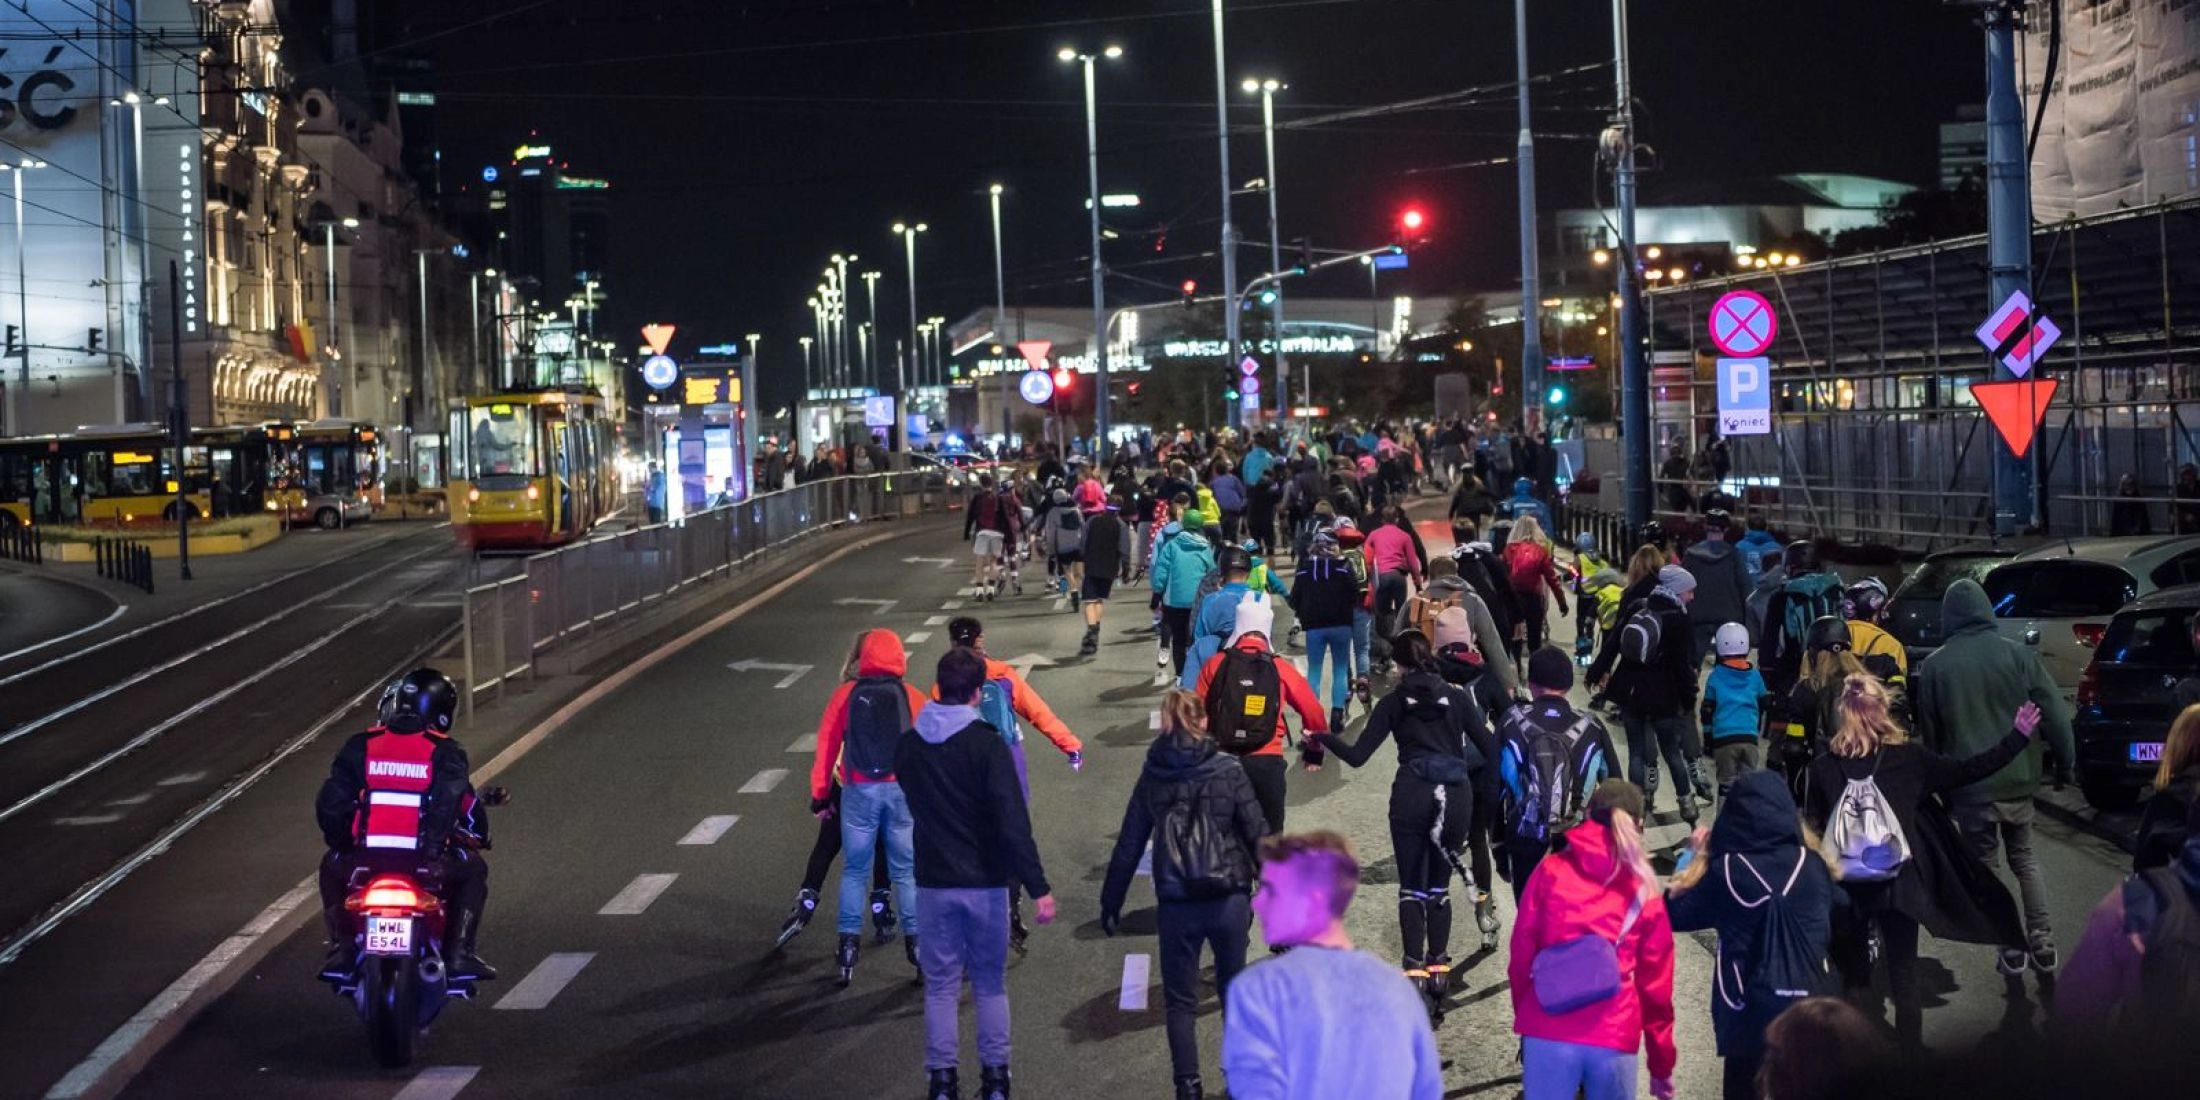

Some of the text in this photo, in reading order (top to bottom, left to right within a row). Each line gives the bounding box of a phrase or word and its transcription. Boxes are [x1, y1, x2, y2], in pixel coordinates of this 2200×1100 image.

[179, 144, 197, 332] POLONIA PALACE
[1729, 363, 1759, 404] P
[1723, 416, 1766, 428] Koniec
[2138, 743, 2158, 760] WN
[368, 760, 429, 779] RATOWNIK
